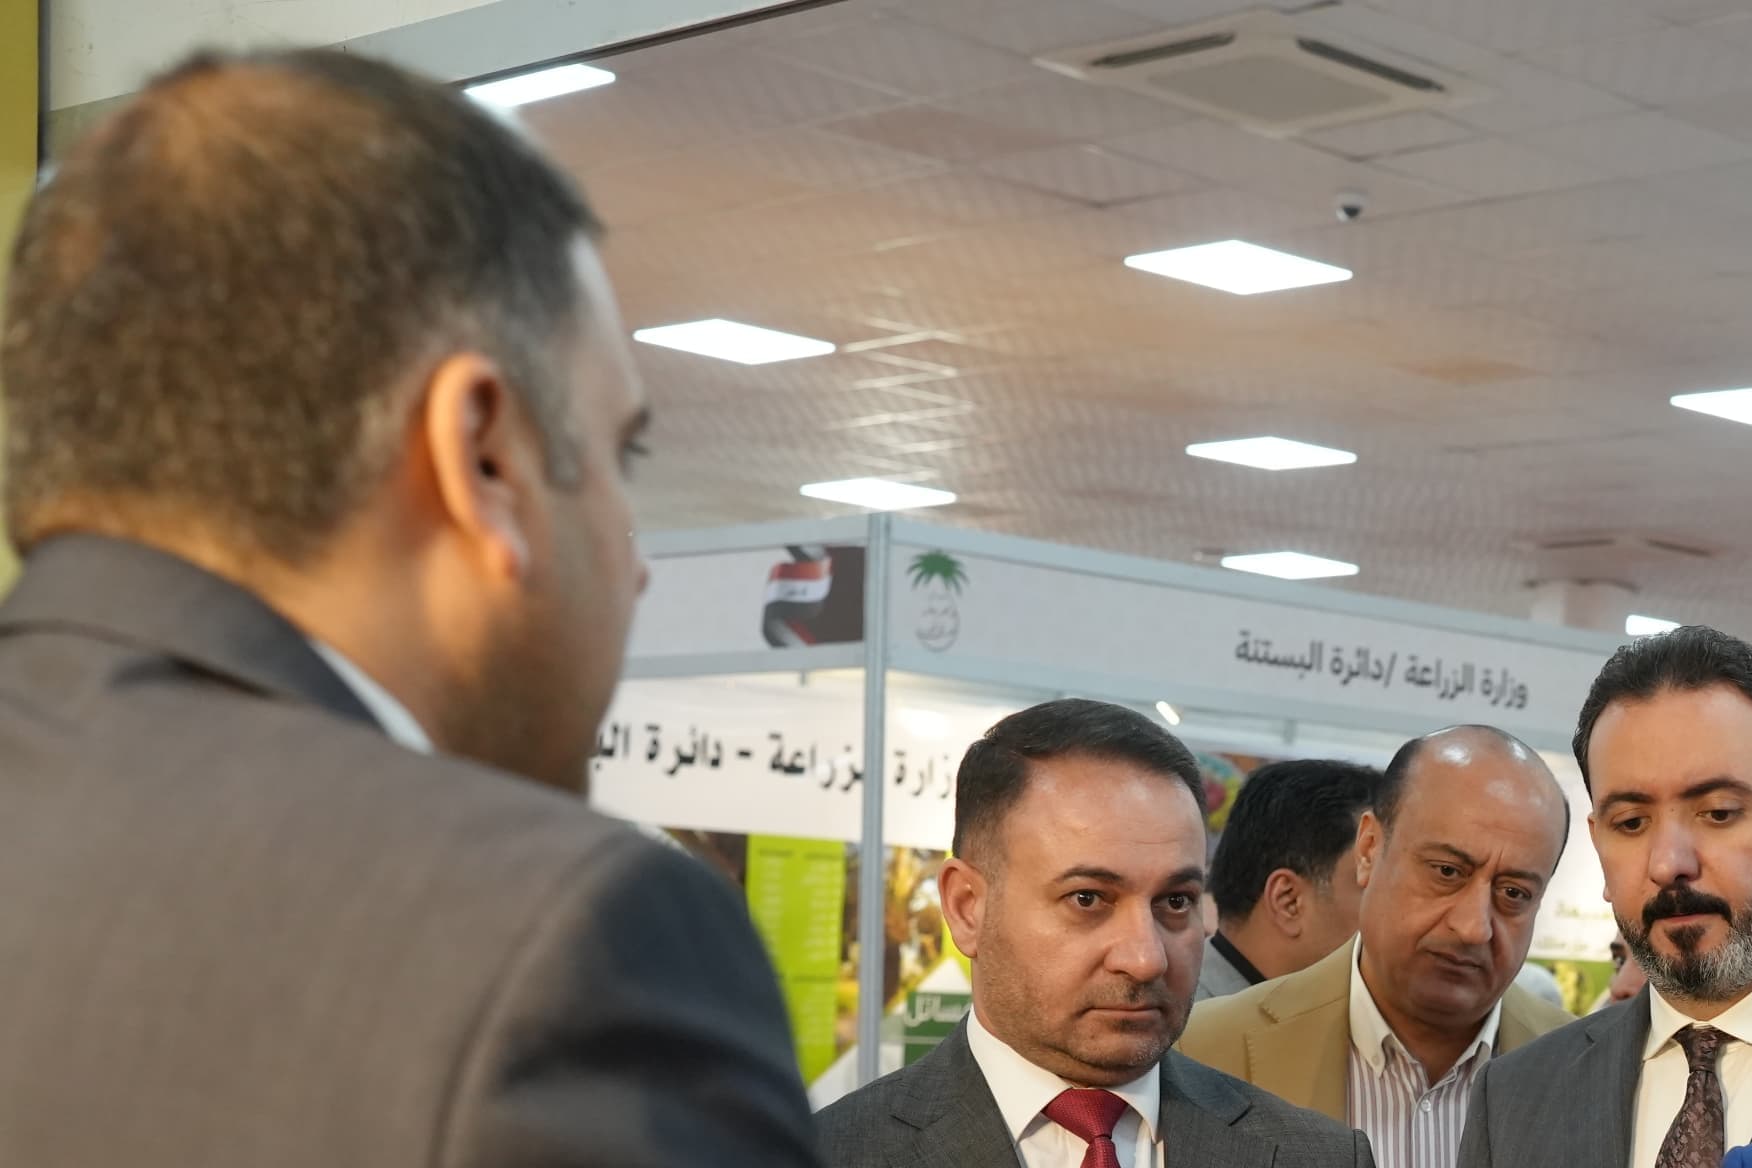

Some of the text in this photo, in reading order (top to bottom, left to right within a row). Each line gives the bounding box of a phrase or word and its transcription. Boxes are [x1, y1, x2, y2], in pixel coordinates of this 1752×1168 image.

[1235, 630, 1323, 679] البستنة
[1404, 654, 1475, 701] الزراعة
[1480, 668, 1528, 709] وزارة
[645, 725, 723, 776] دائرة
[768, 733, 866, 791] زراعة
[894, 751, 952, 798] زارة
